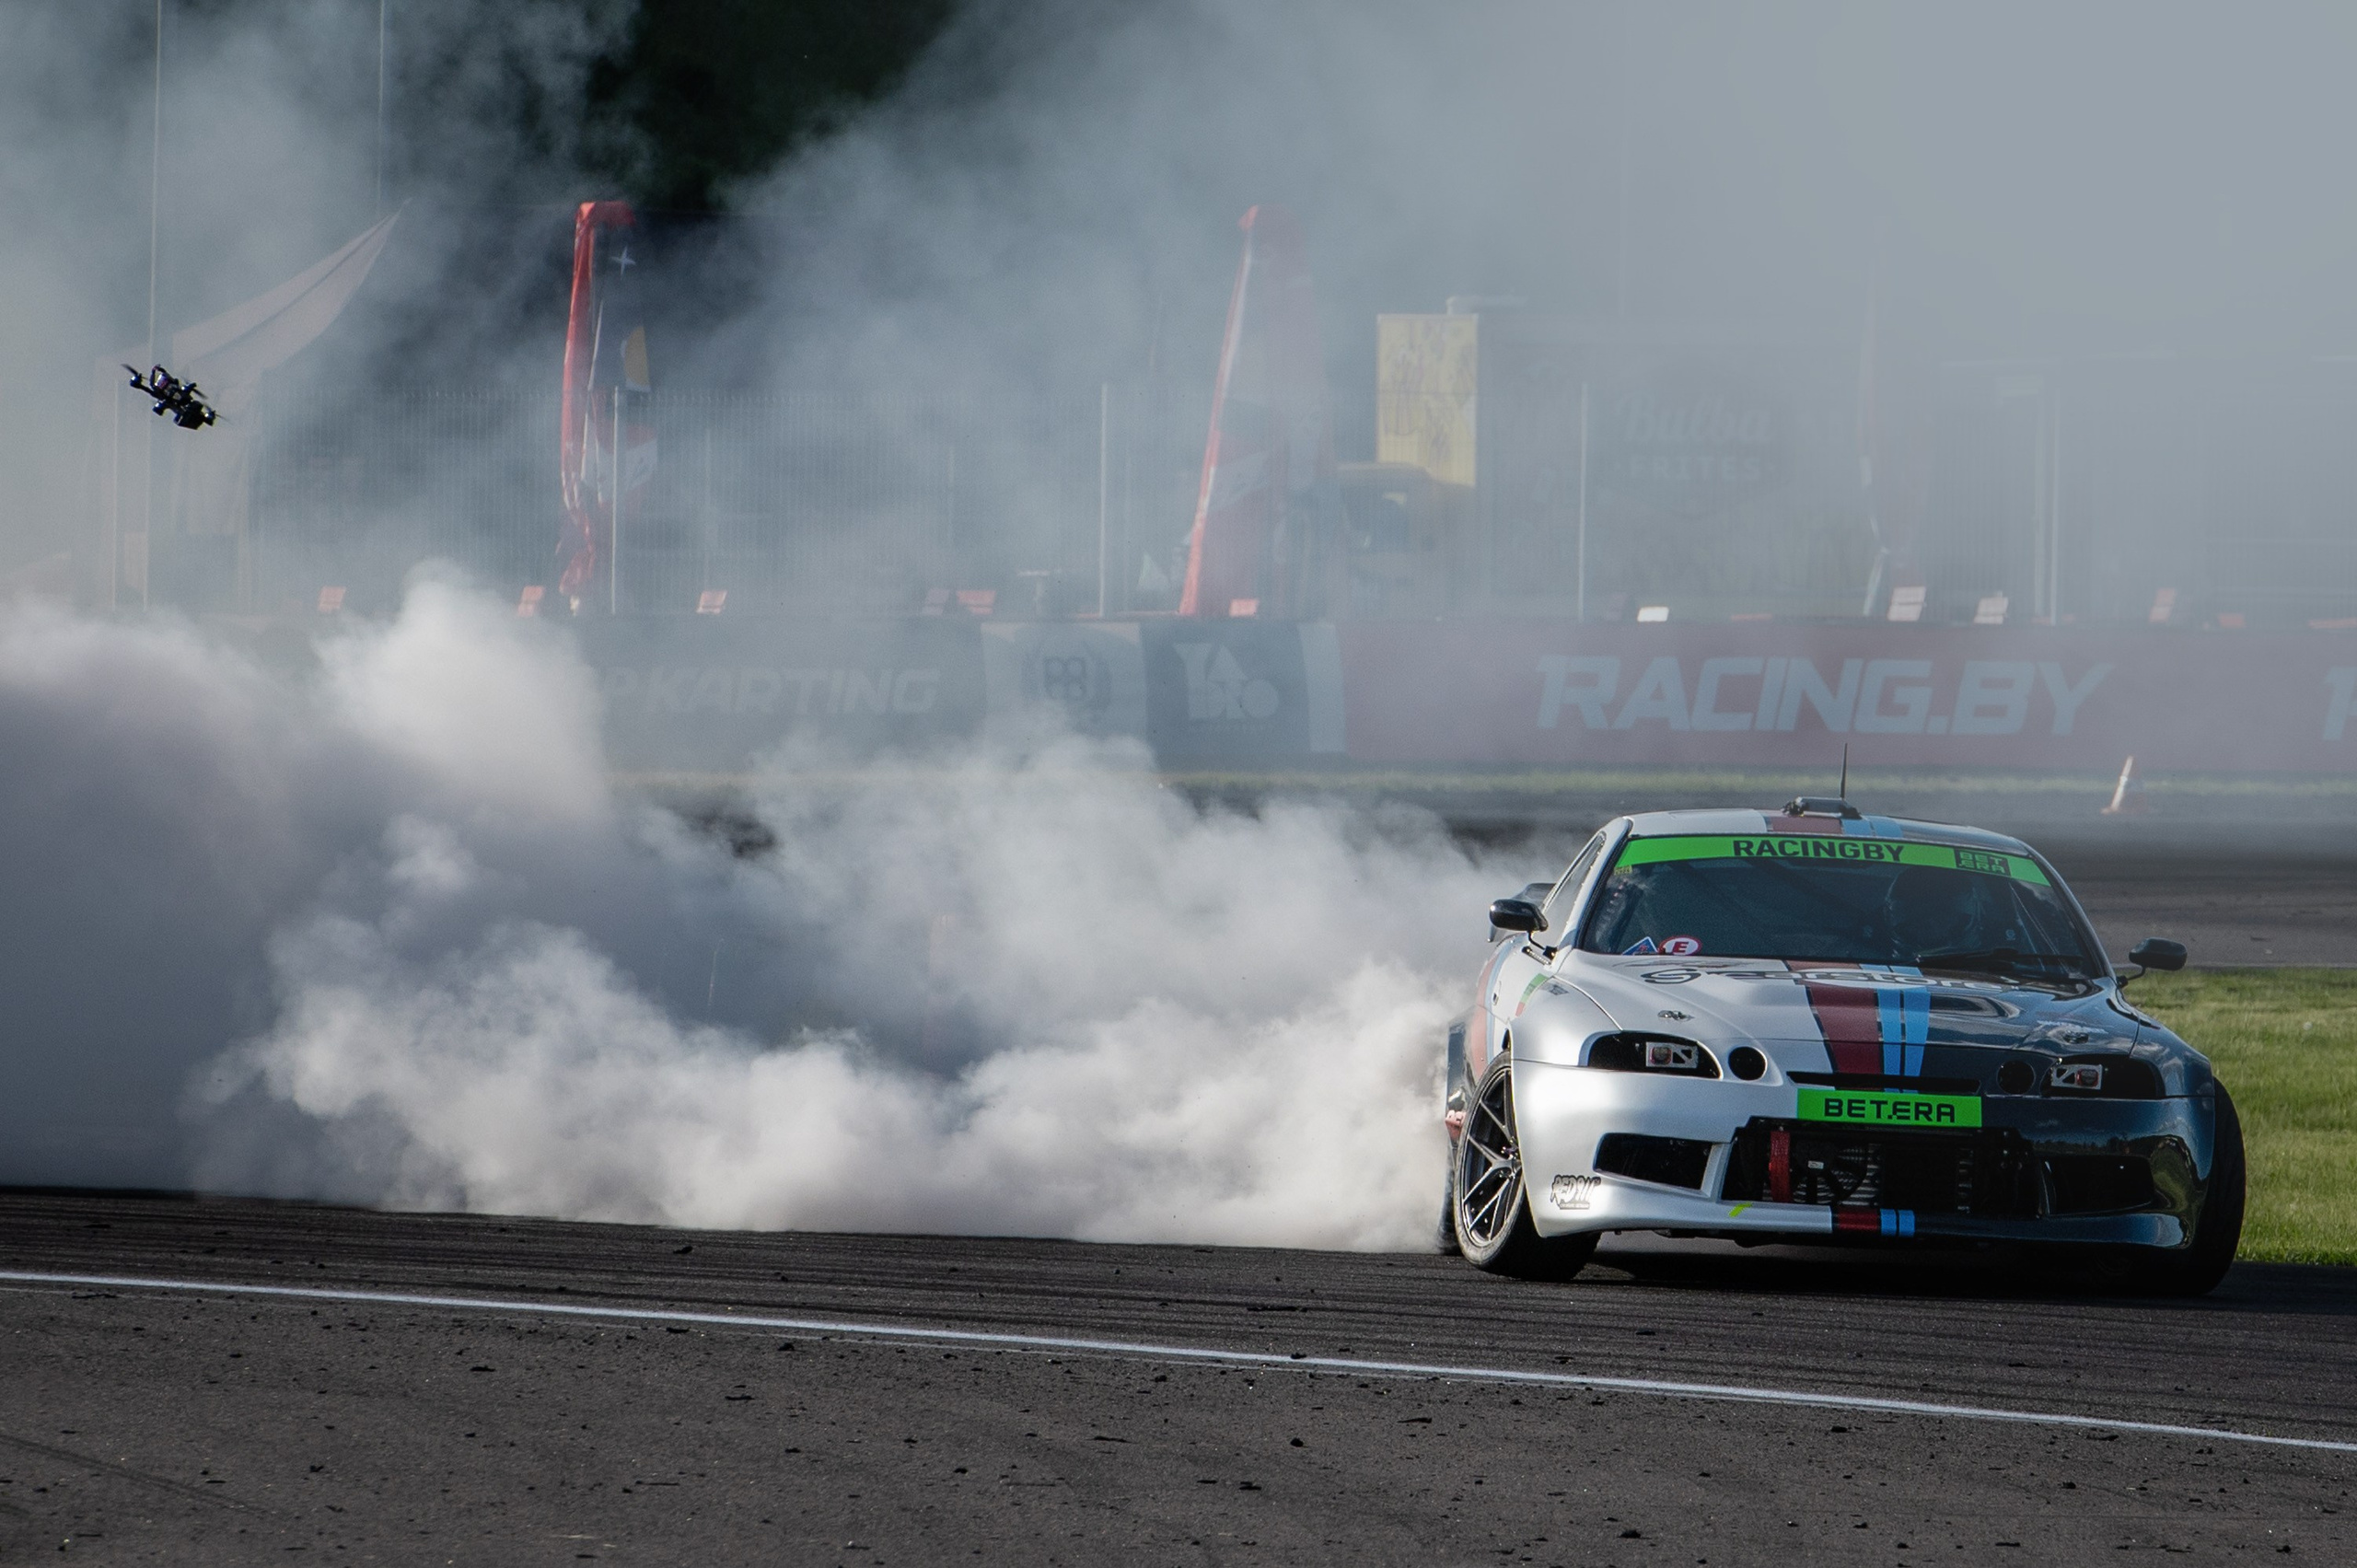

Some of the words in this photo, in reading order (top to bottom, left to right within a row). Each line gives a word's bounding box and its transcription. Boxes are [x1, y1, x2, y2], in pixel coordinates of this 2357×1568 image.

[1629, 454, 1762, 483] FRITES
[644, 665, 941, 714] KARTING
[1535, 655, 2116, 737] RACING.BY
[1733, 839, 1905, 863] RACINGBY
[1824, 1098, 1956, 1123] BET.ERA
